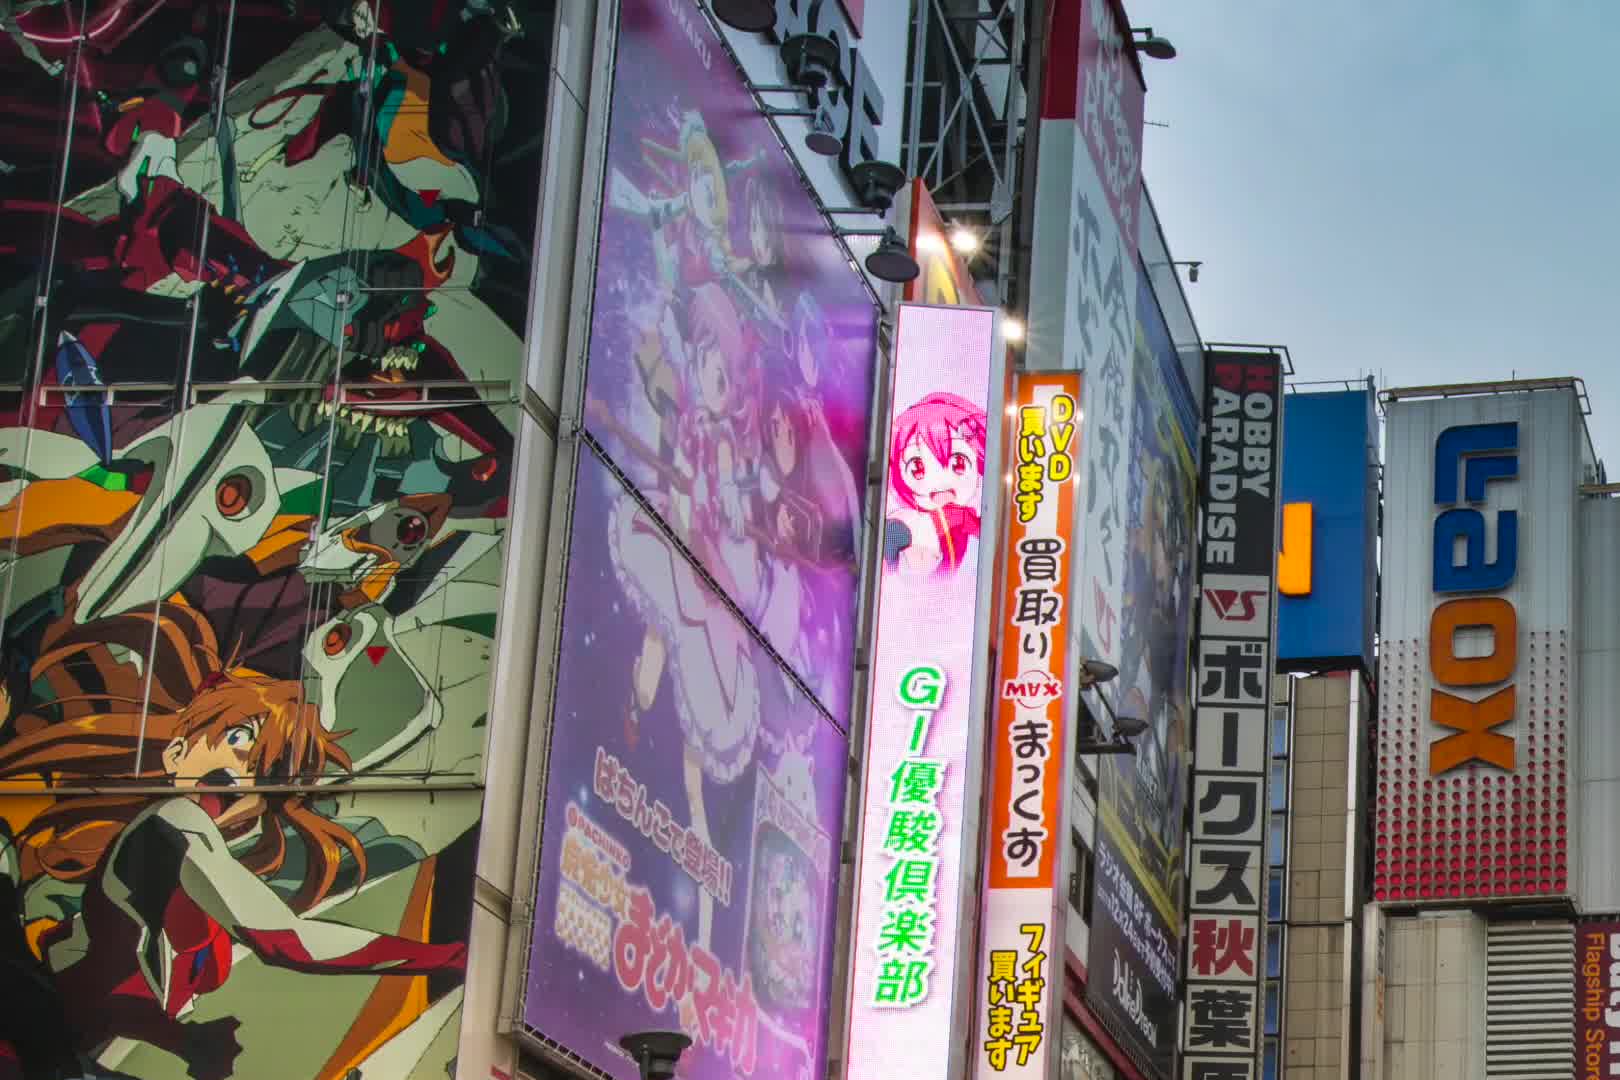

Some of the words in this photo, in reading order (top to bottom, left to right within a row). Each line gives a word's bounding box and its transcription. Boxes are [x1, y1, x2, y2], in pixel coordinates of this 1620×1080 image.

[1015, 406, 1047, 523] 買います
[1051, 395, 1074, 482] DVD
[1206, 363, 1241, 565] PARADISE
[1242, 363, 1273, 498] HOBBY
[1016, 537, 1063, 660] 買取り
[1007, 719, 1049, 868] まっくす
[985, 949, 1018, 1071] 買います
[1013, 922, 1047, 1067] フィギュア
[1580, 931, 1606, 1022] Flagship
